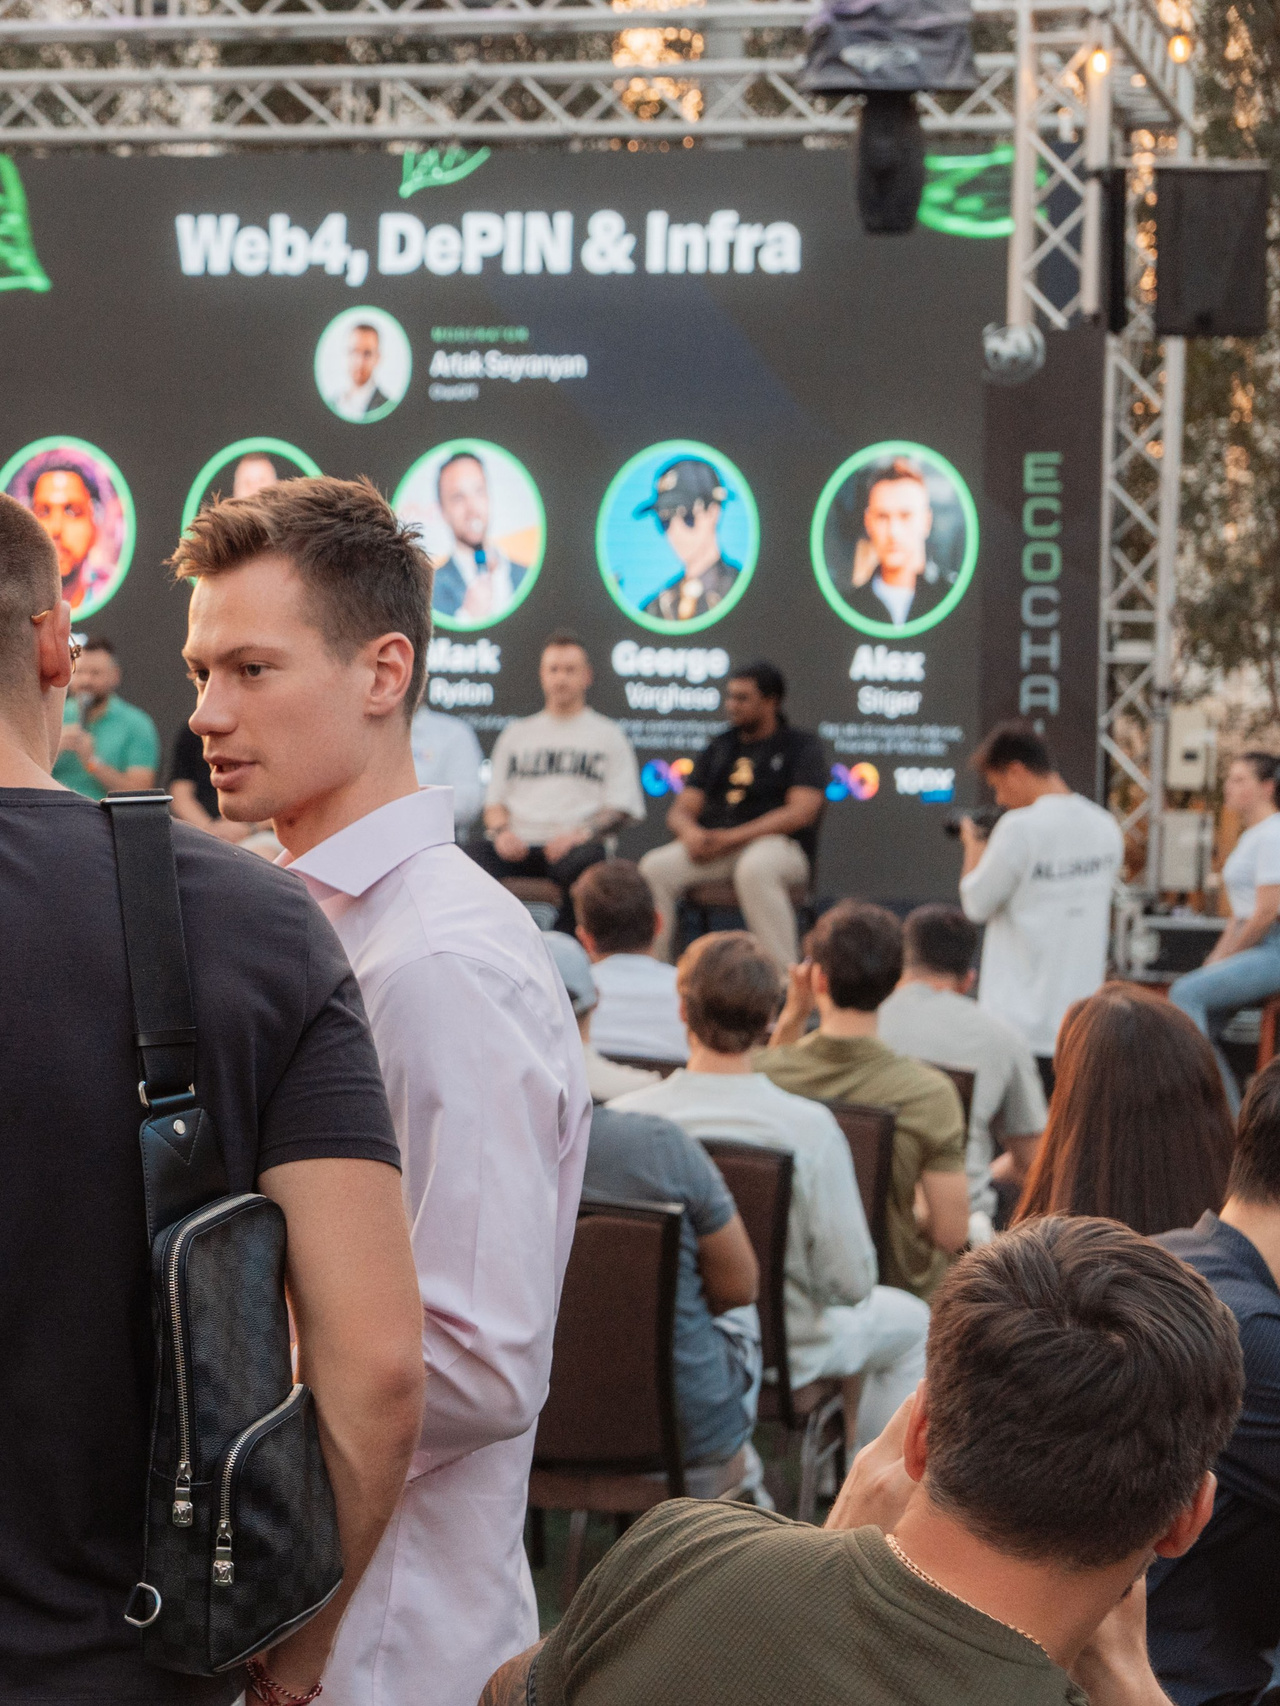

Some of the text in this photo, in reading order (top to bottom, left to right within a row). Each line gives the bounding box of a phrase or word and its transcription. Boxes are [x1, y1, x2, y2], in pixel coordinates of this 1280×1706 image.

[175, 209, 802, 287] Web4, DePIN & Infra
[611, 639, 730, 684] George
[849, 644, 926, 682] Alex
[625, 681, 720, 715] Varghese
